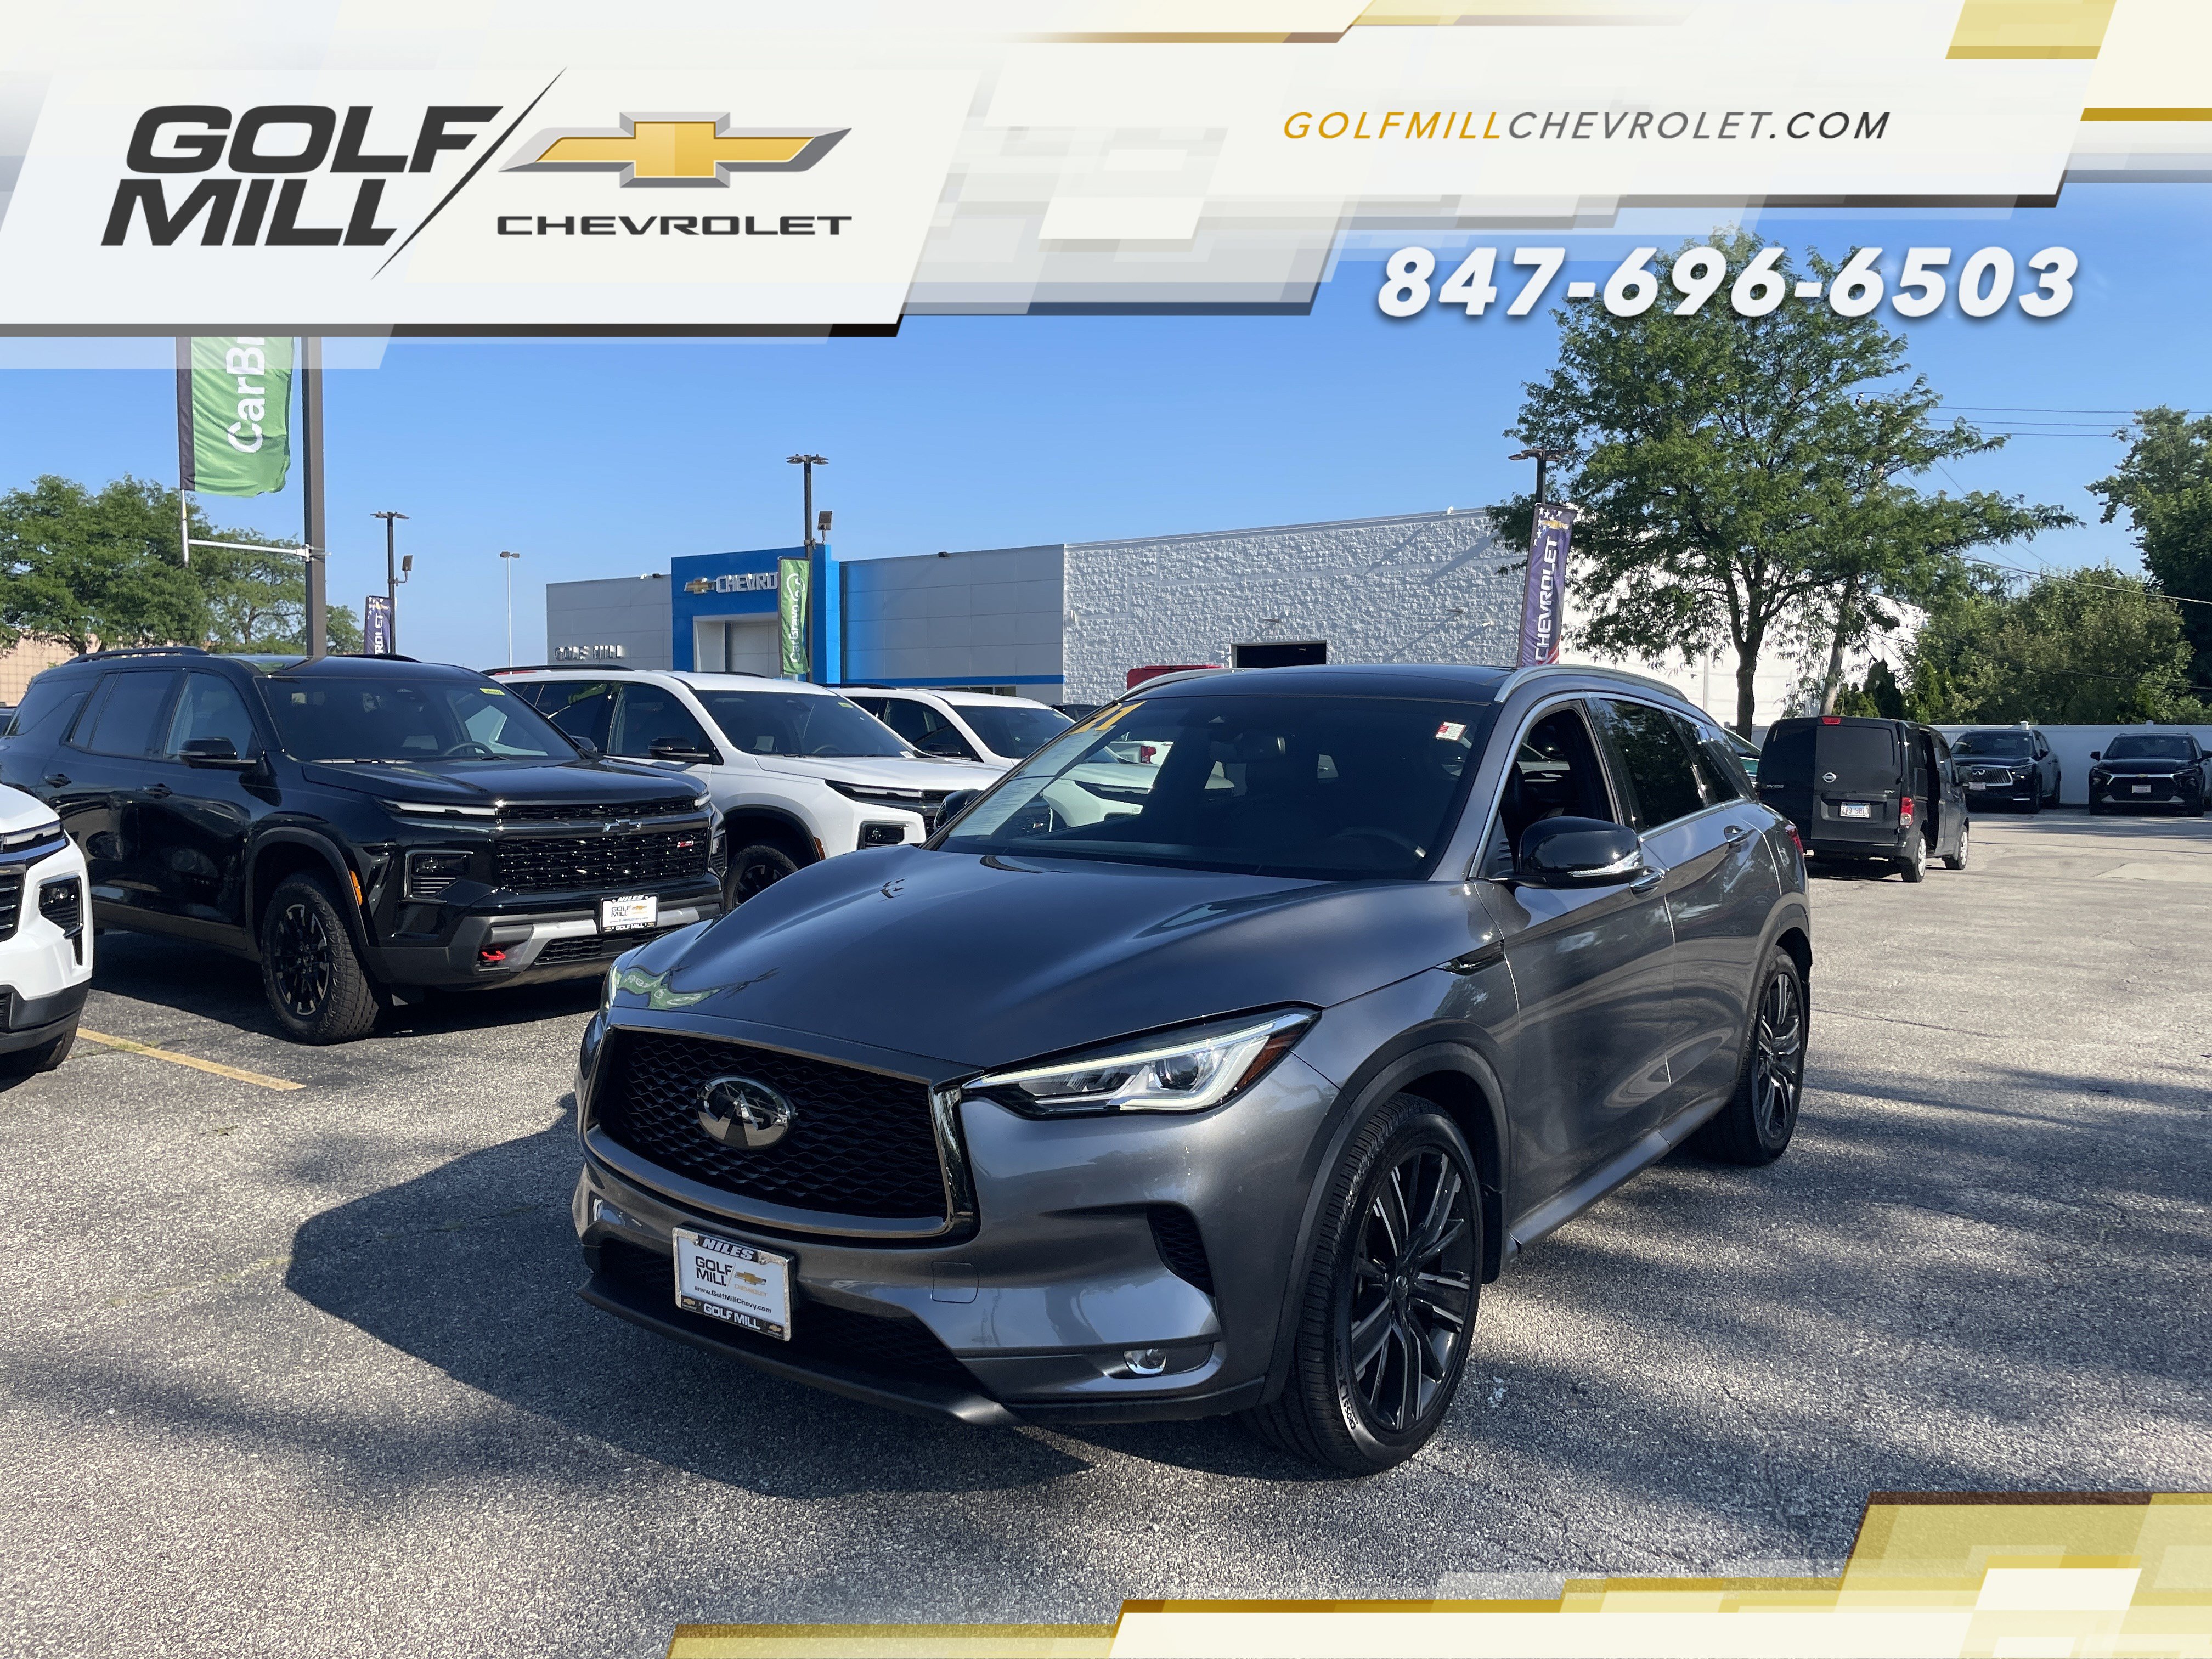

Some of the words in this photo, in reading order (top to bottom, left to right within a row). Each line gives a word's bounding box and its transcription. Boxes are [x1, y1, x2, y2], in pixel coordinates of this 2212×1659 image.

[1534, 535, 1558, 661] CHEVROLET
[789, 604, 800, 663] CarBravo
[702, 1238, 754, 1260] NILES
[695, 1255, 733, 1276] GOLF
[696, 1267, 727, 1287] MILL
[695, 1285, 772, 1314] www.GolfMillChevy.com
[703, 1303, 733, 1321] GOLF
[734, 1312, 761, 1330] MILL
[1343, 1400, 1356, 1430] CROSS
